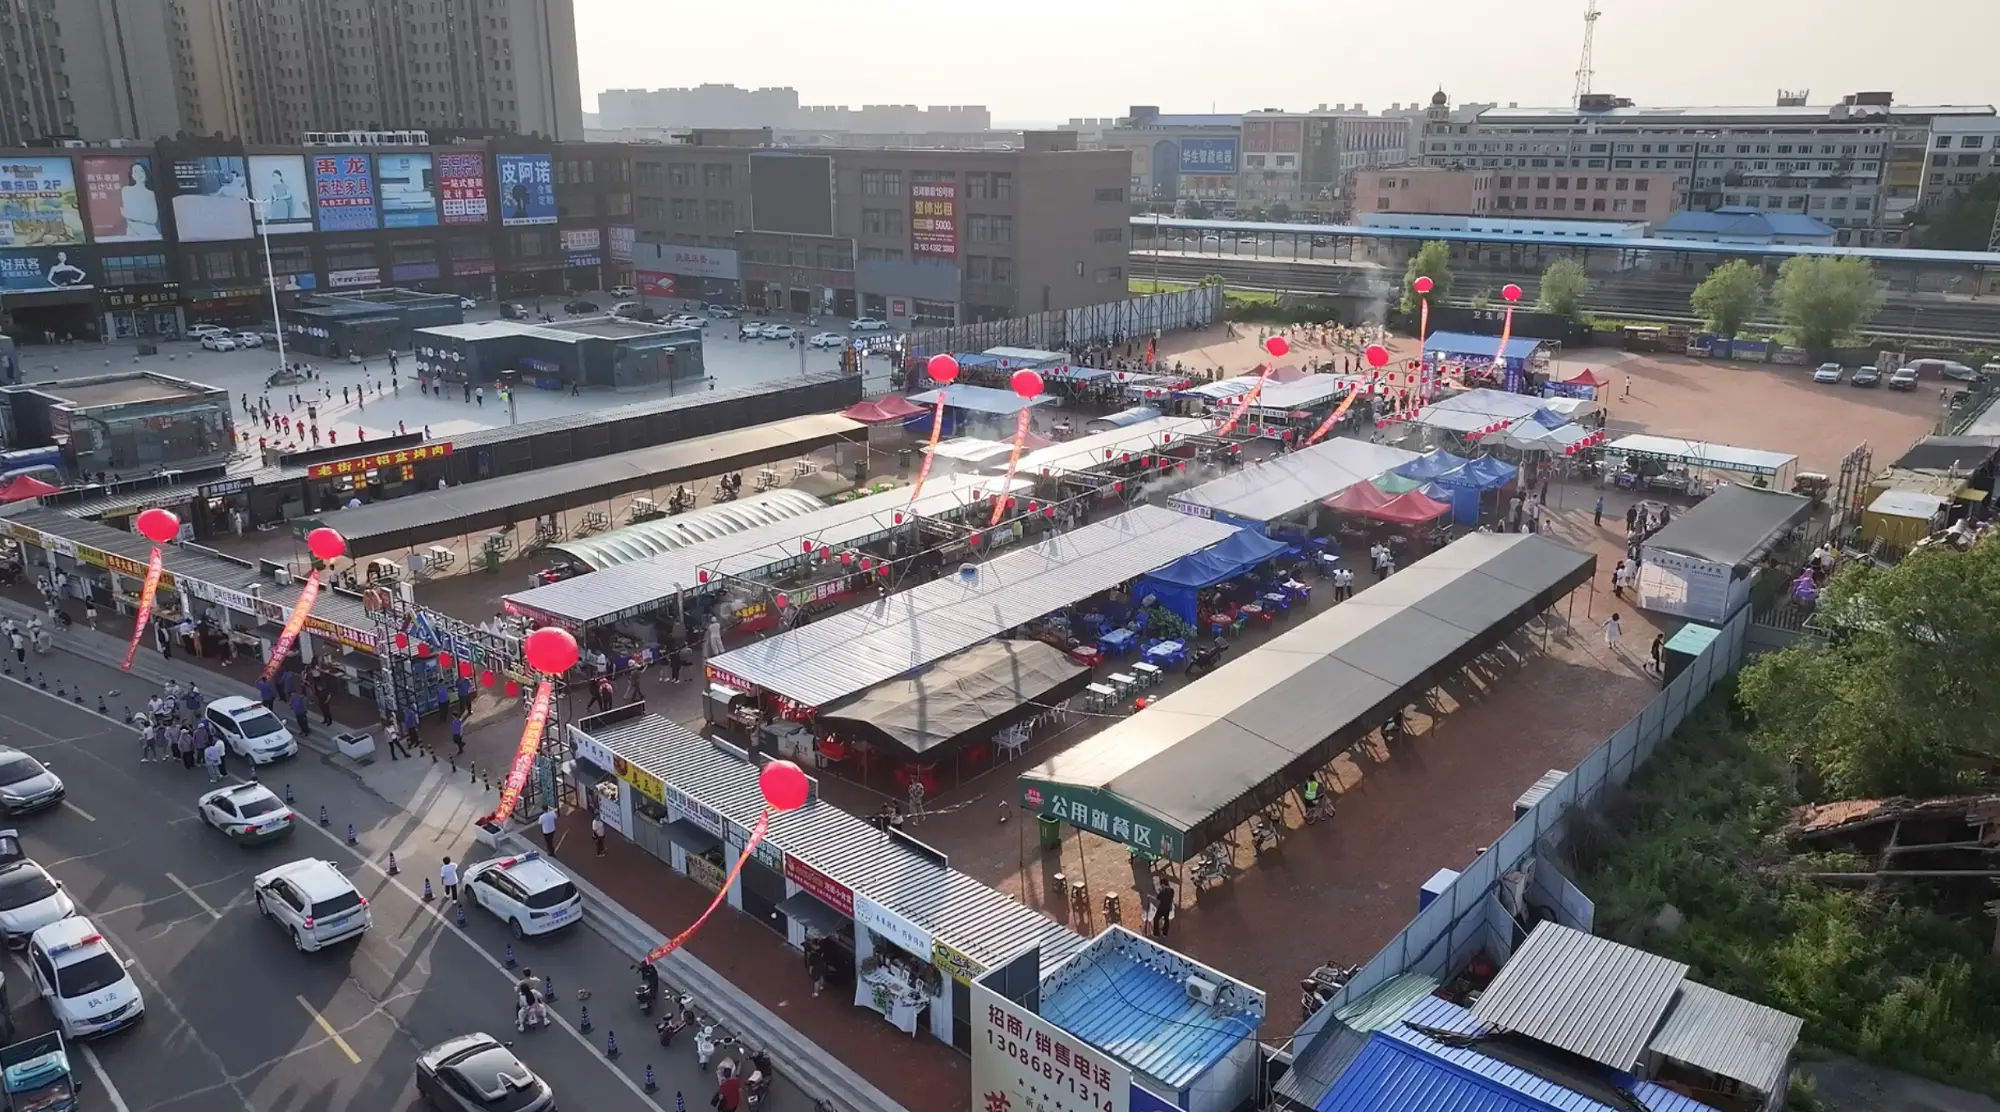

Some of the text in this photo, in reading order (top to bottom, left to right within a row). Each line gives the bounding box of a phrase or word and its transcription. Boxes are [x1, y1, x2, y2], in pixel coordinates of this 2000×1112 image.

[316, 156, 367, 175] 禹龙
[501, 161, 550, 184] 皮阿诺
[44, 180, 61, 190] 2F
[317, 178, 370, 195] 床垫家具
[915, 200, 952, 216] 整体出租
[1, 258, 40, 271] 好莱客
[1473, 311, 1505, 320] 卫生间
[318, 446, 444, 476] 老街小铝盆烤肉
[1052, 795, 1151, 848] 公用就餐区
[88, 992, 117, 1008] 执法
[988, 1004, 1111, 1092] 招商/销售电话
[987, 1029, 1113, 1112] 13086871314
